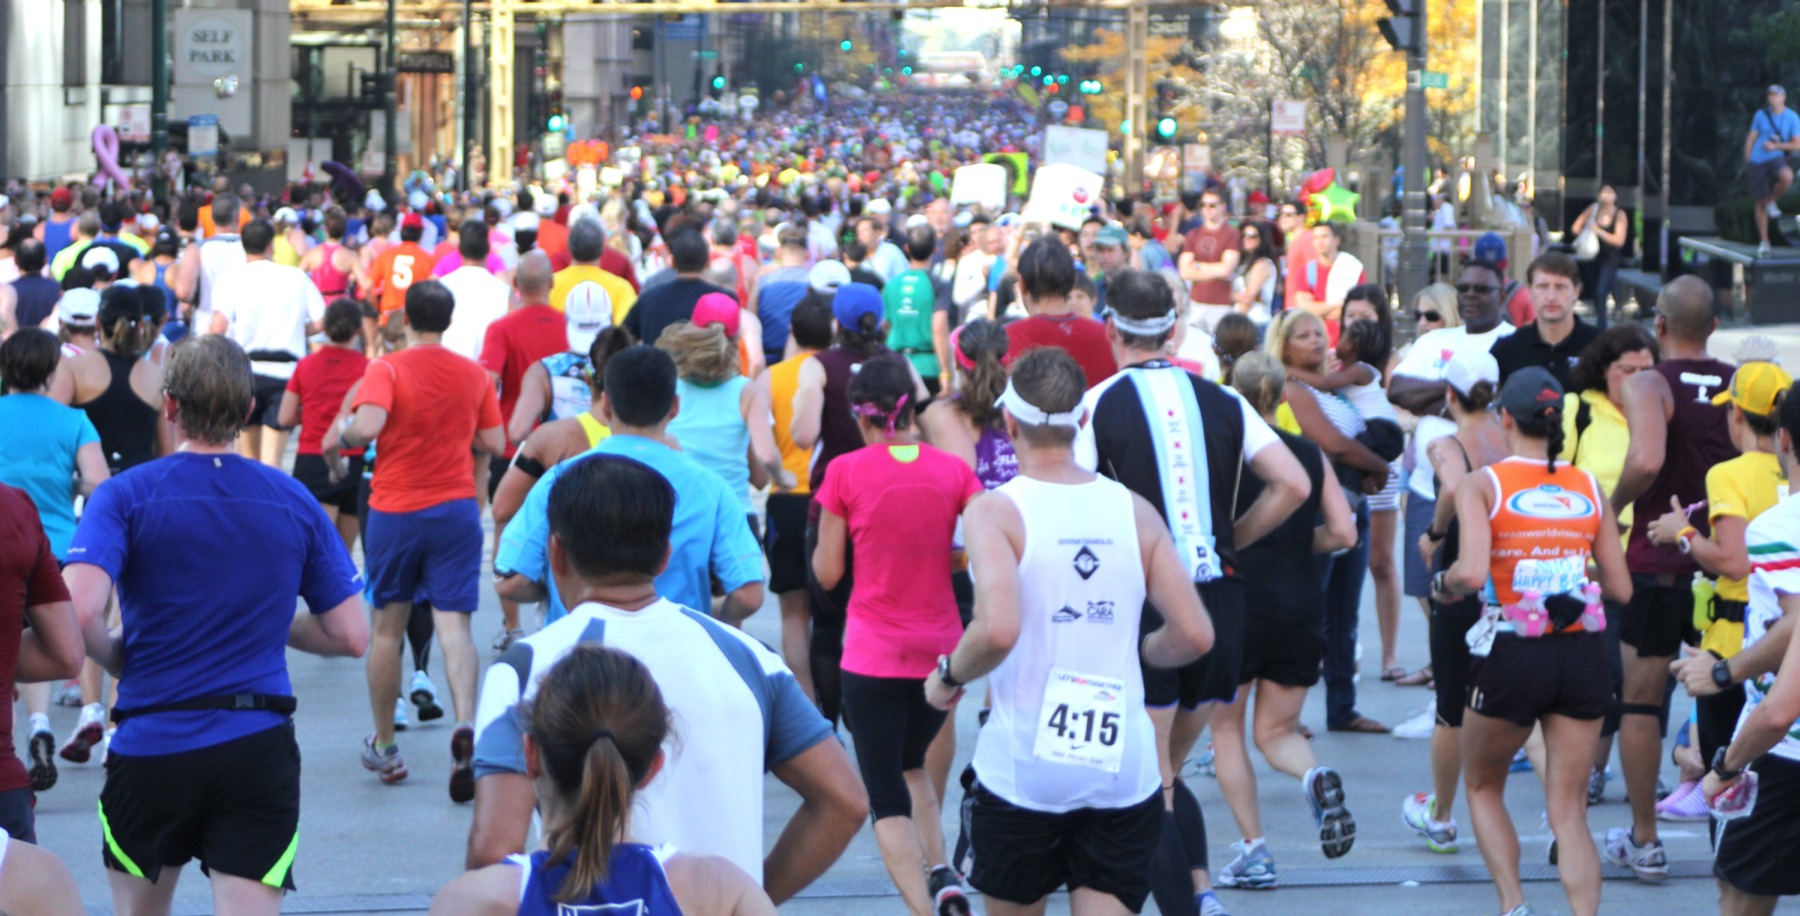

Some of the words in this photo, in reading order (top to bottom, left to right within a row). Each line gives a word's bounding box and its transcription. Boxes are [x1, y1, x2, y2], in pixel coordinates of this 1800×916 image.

[192, 29, 232, 43] SELF
[190, 49, 234, 62] PARK
[391, 254, 415, 288] 5
[1530, 545, 1560, 556] And
[1513, 573, 1553, 588] HAPPY
[1087, 606, 1114, 616] CARA
[1048, 703, 1120, 746] 4:15
